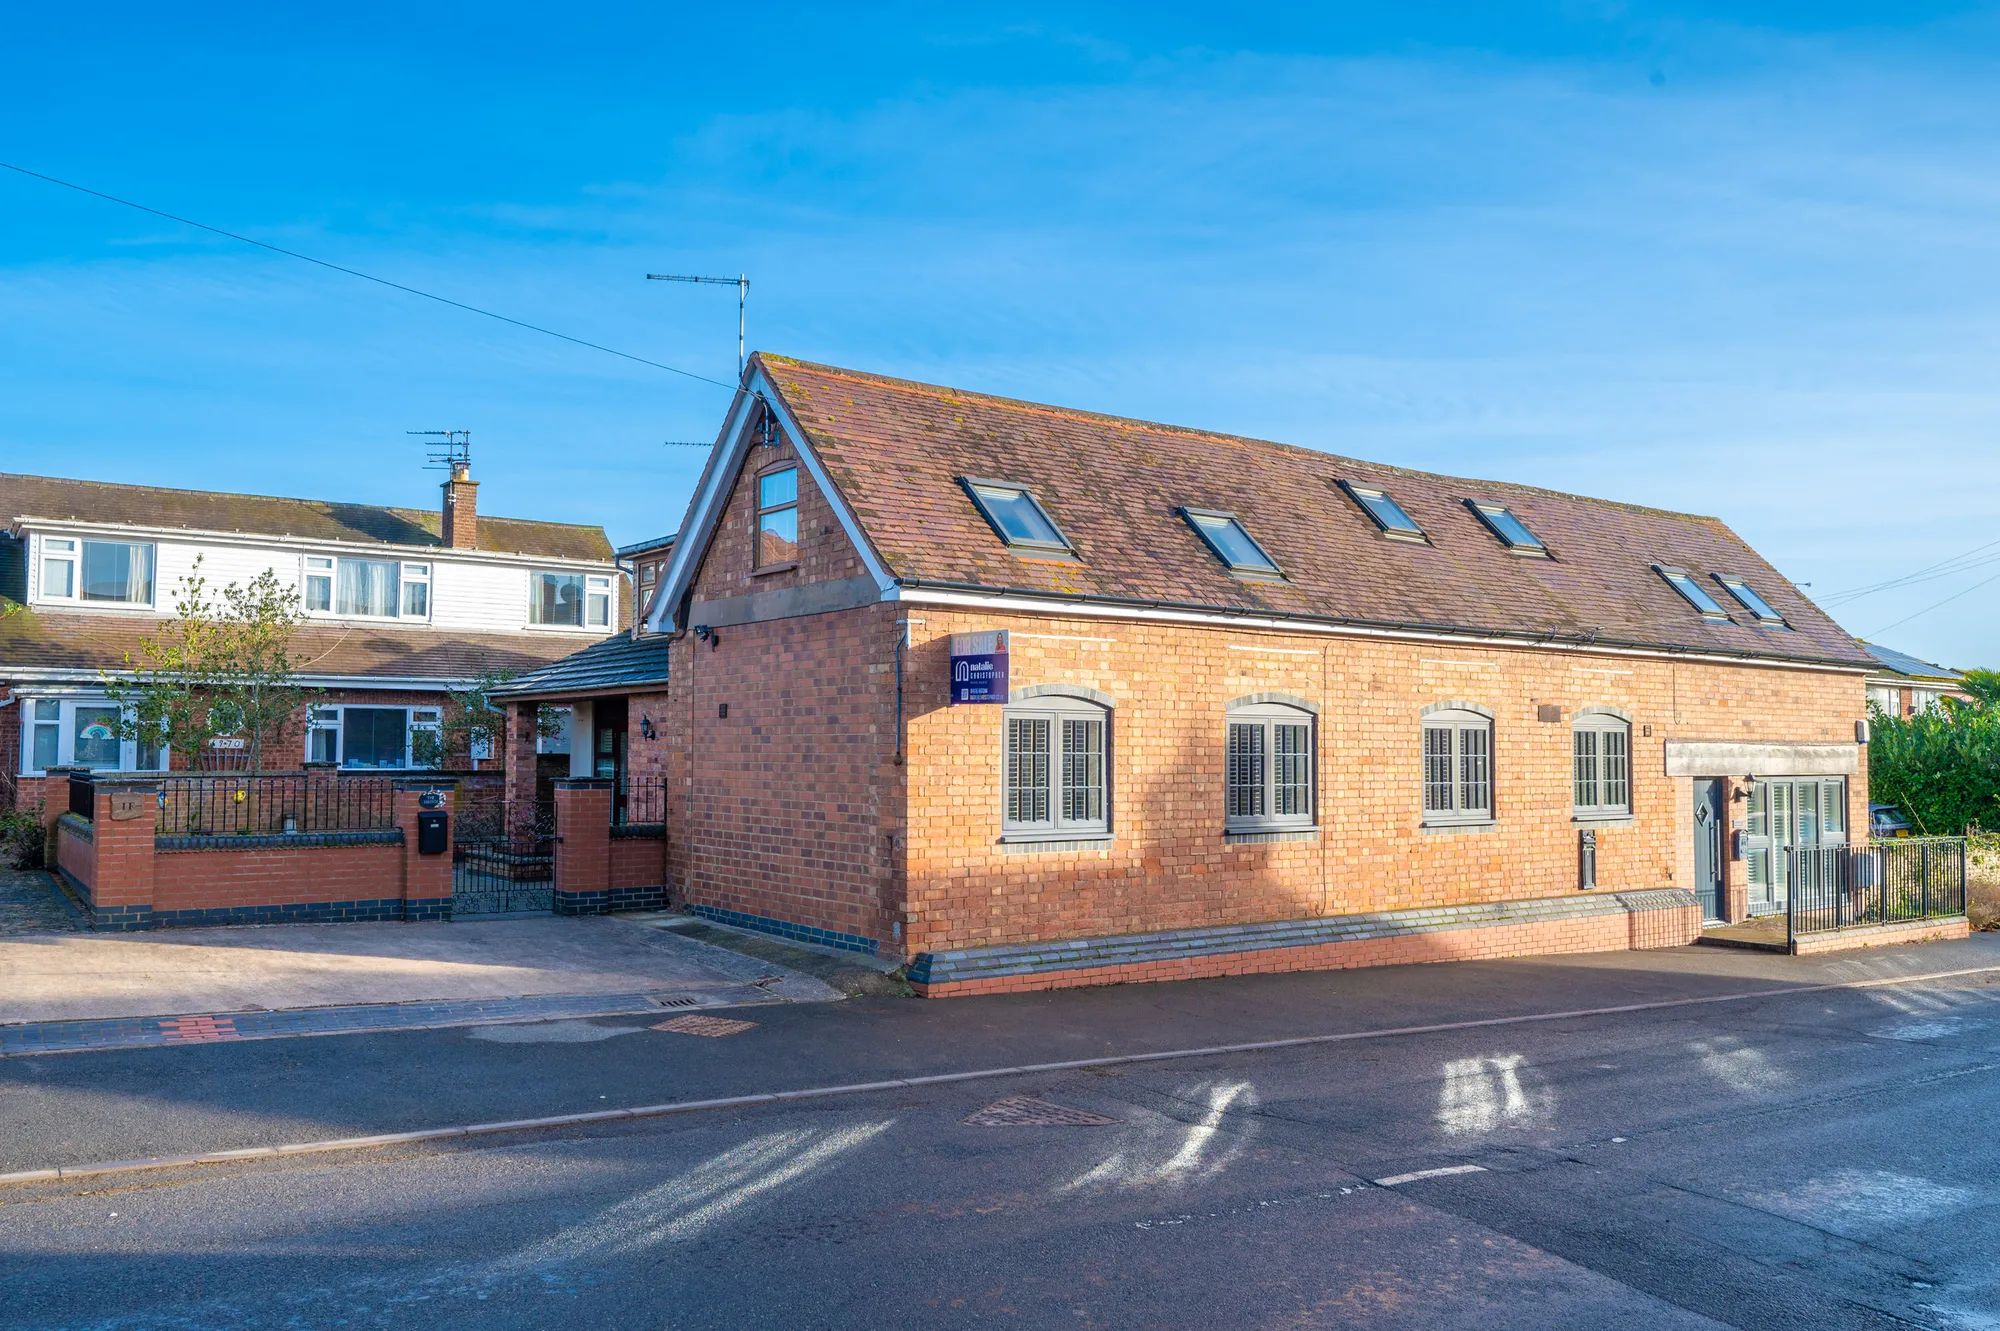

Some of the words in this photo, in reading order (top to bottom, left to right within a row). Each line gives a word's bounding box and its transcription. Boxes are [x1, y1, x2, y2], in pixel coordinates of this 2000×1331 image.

[955, 637, 970, 655] FOR
[972, 635, 993, 655] SALE
[970, 661, 993, 671] natalie
[970, 671, 1004, 679] CHRISTOPHER
